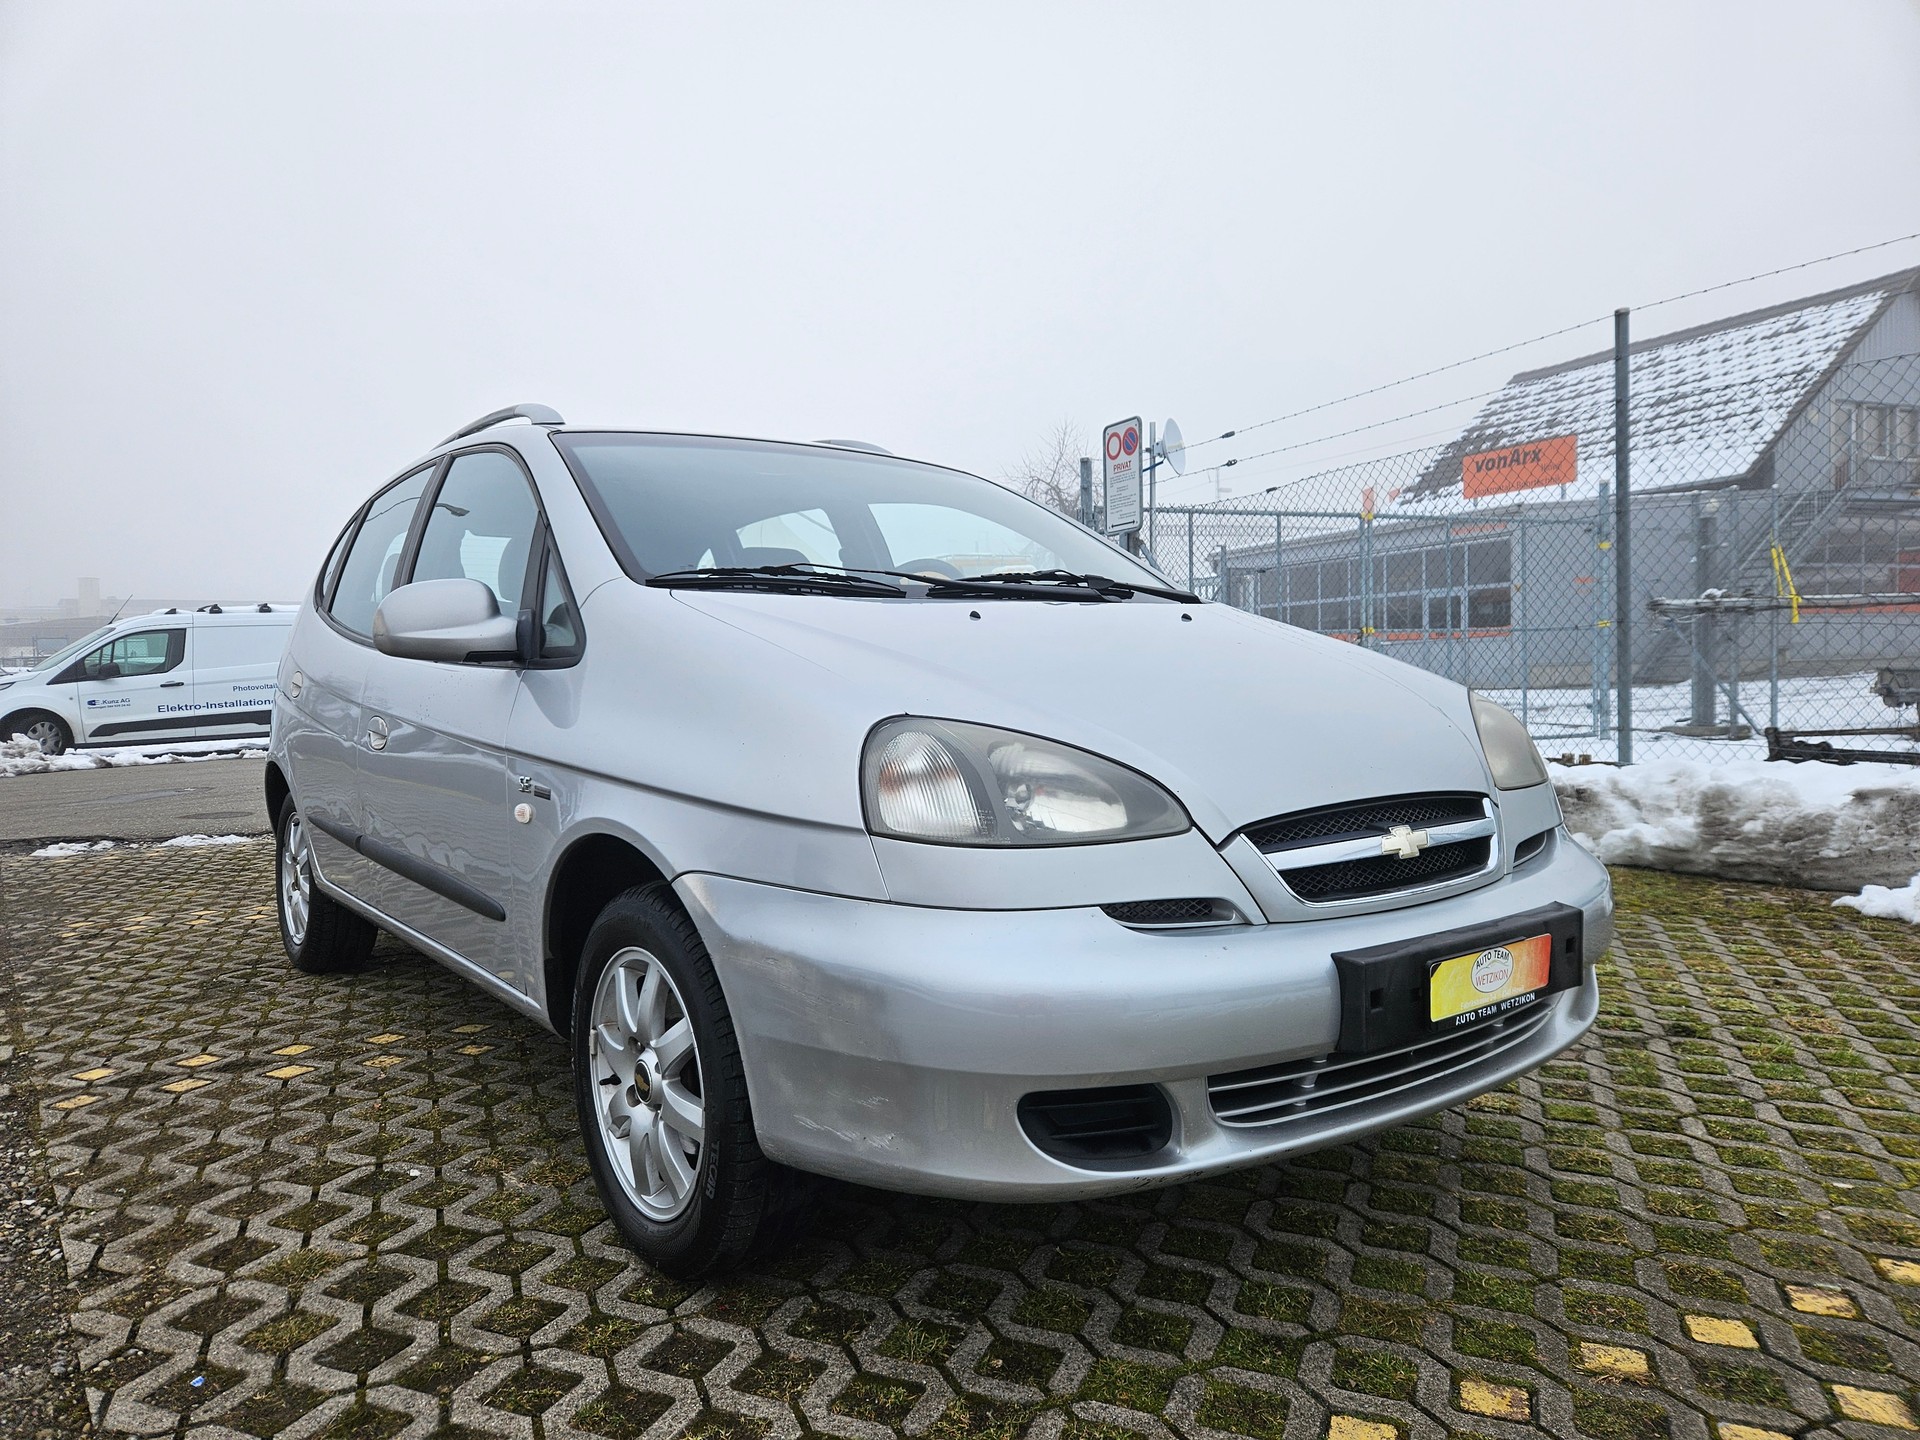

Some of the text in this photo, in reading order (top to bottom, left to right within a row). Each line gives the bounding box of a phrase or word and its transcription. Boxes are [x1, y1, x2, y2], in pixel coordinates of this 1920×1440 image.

[1113, 460, 1132, 472] PRIVAT
[1475, 447, 1542, 473] vonArx
[1476, 949, 1510, 970] AUTO TEAM
[1475, 968, 1509, 986] WETZIKON
[1455, 1012, 1476, 1026] AUTO
[1478, 1005, 1498, 1018] TEAM
[1501, 992, 1536, 1011] WETZIKON
